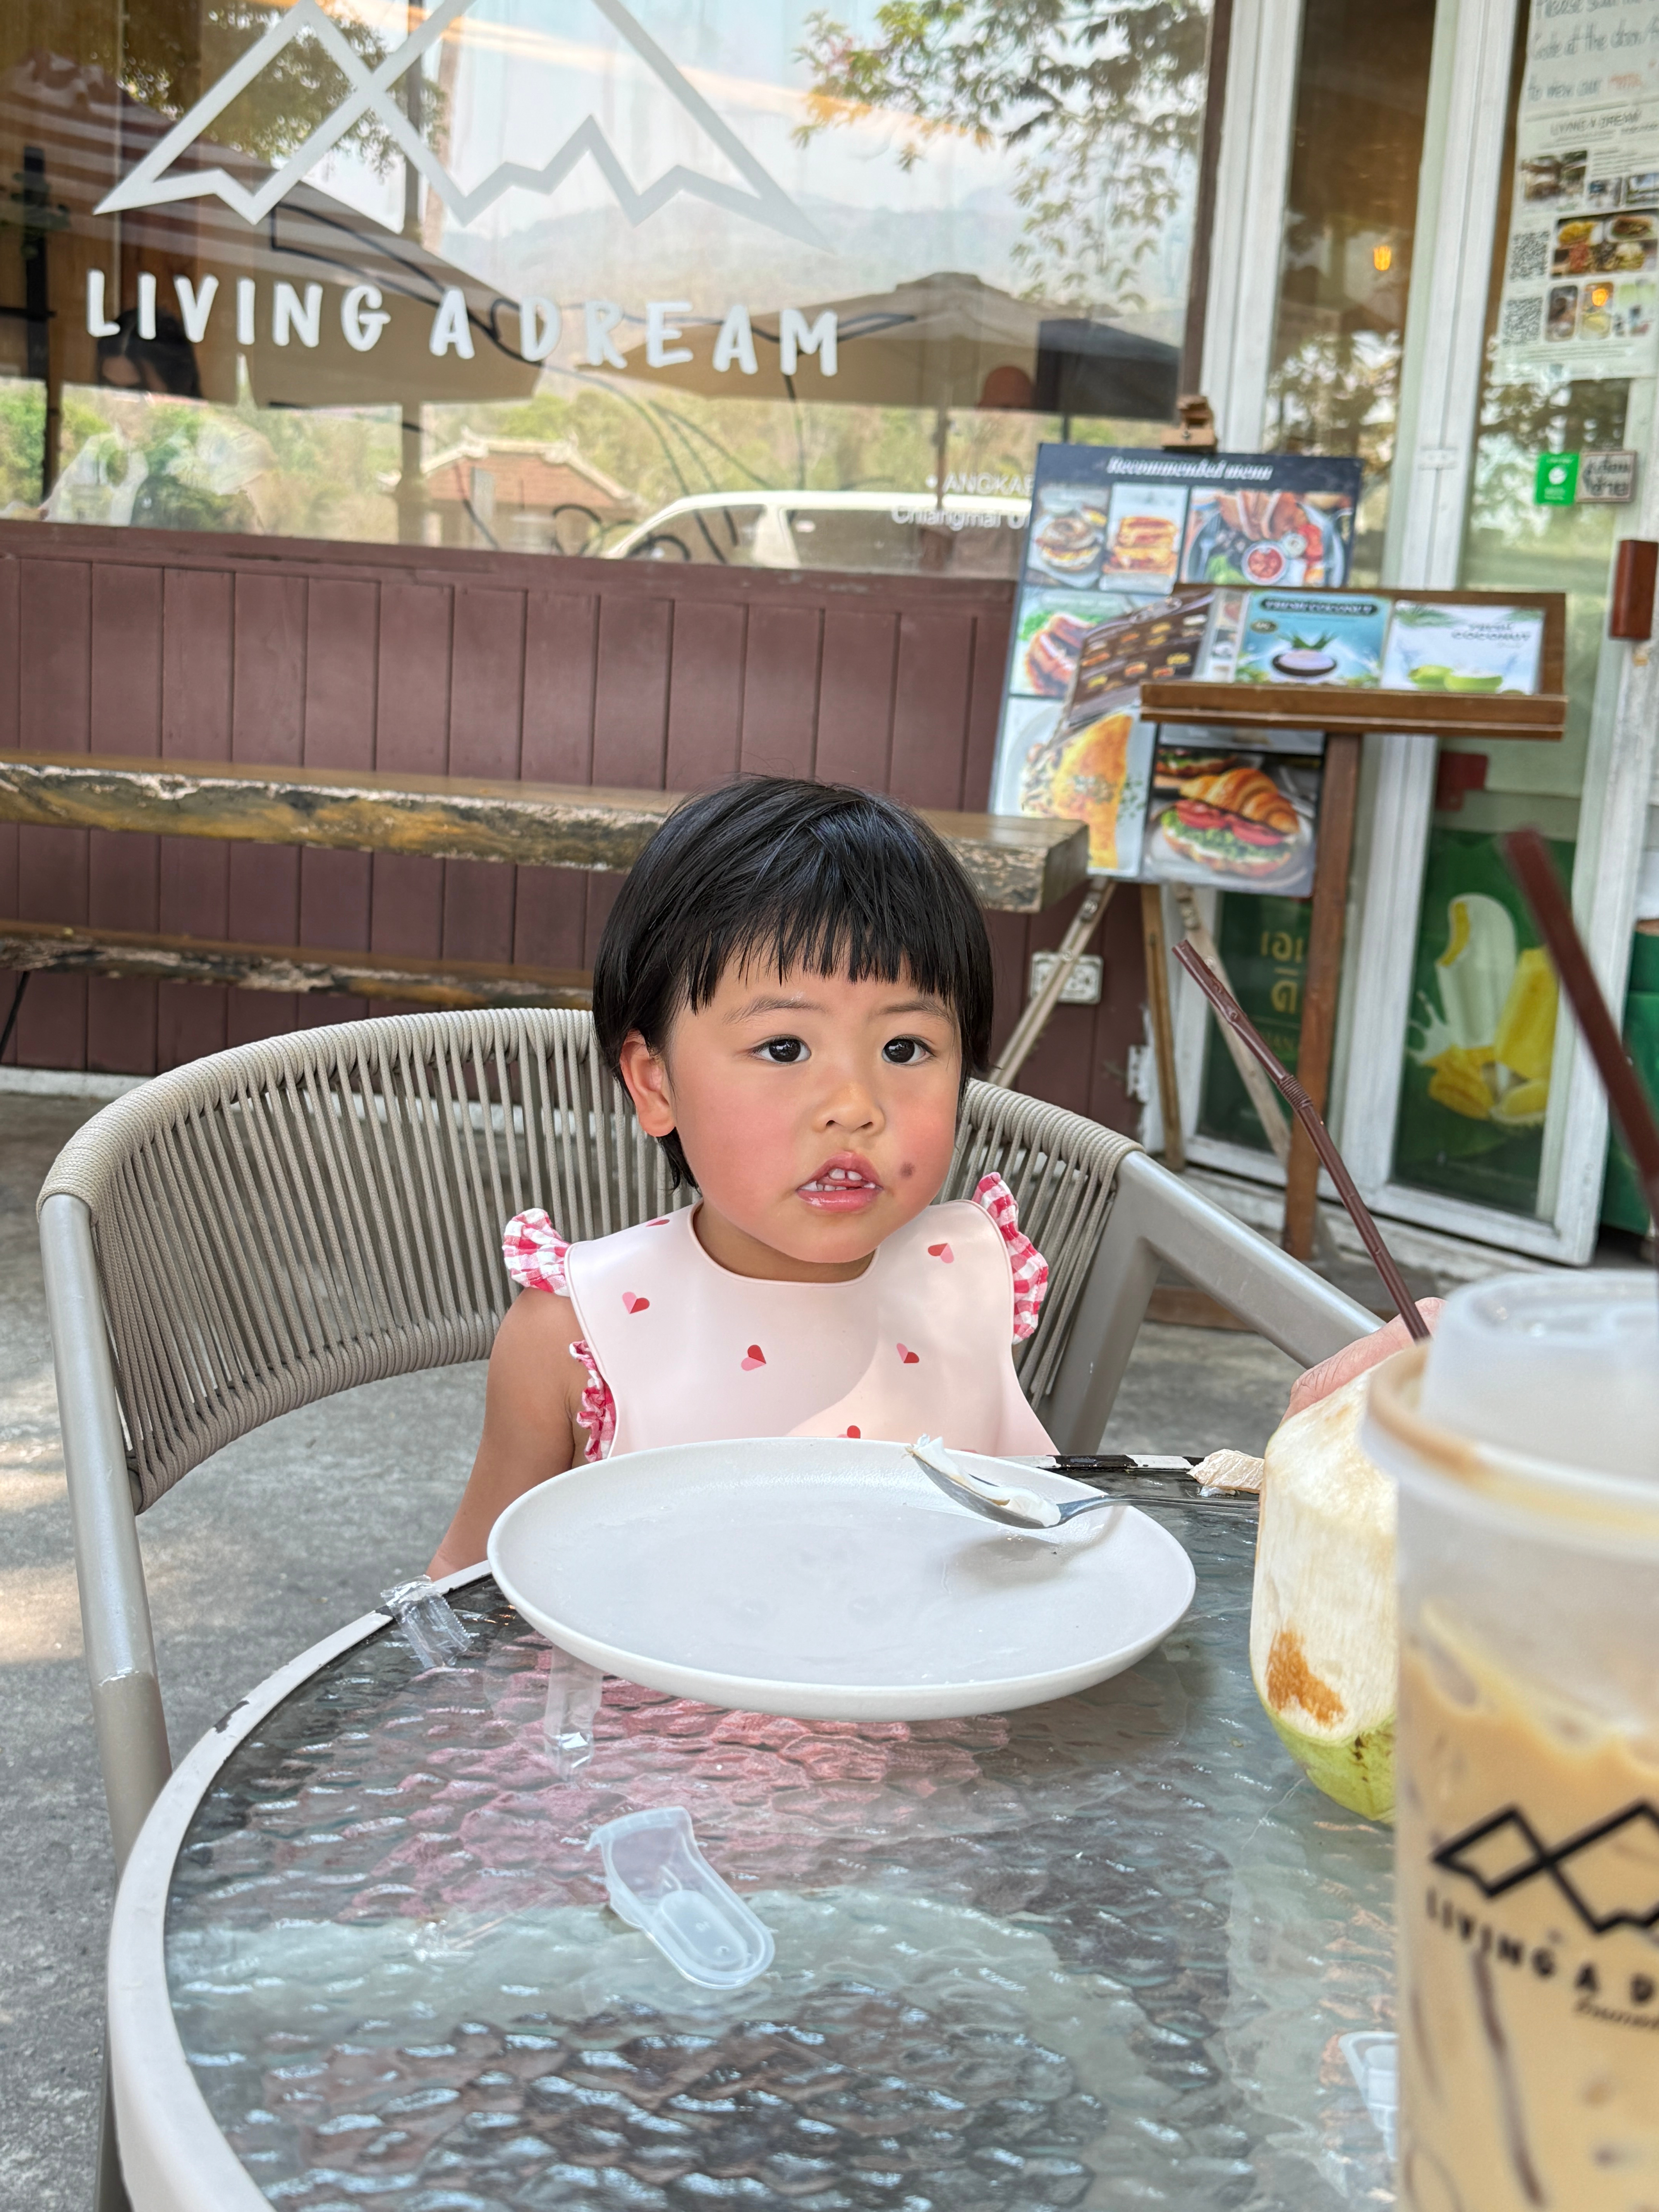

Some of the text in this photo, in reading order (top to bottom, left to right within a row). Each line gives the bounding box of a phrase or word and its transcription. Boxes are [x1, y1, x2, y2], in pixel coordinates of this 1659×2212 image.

[86, 268, 838, 377] LIVING A DREAM
[1106, 455, 1274, 481] Recommended menu
[1575, 1962, 1599, 1992] A
